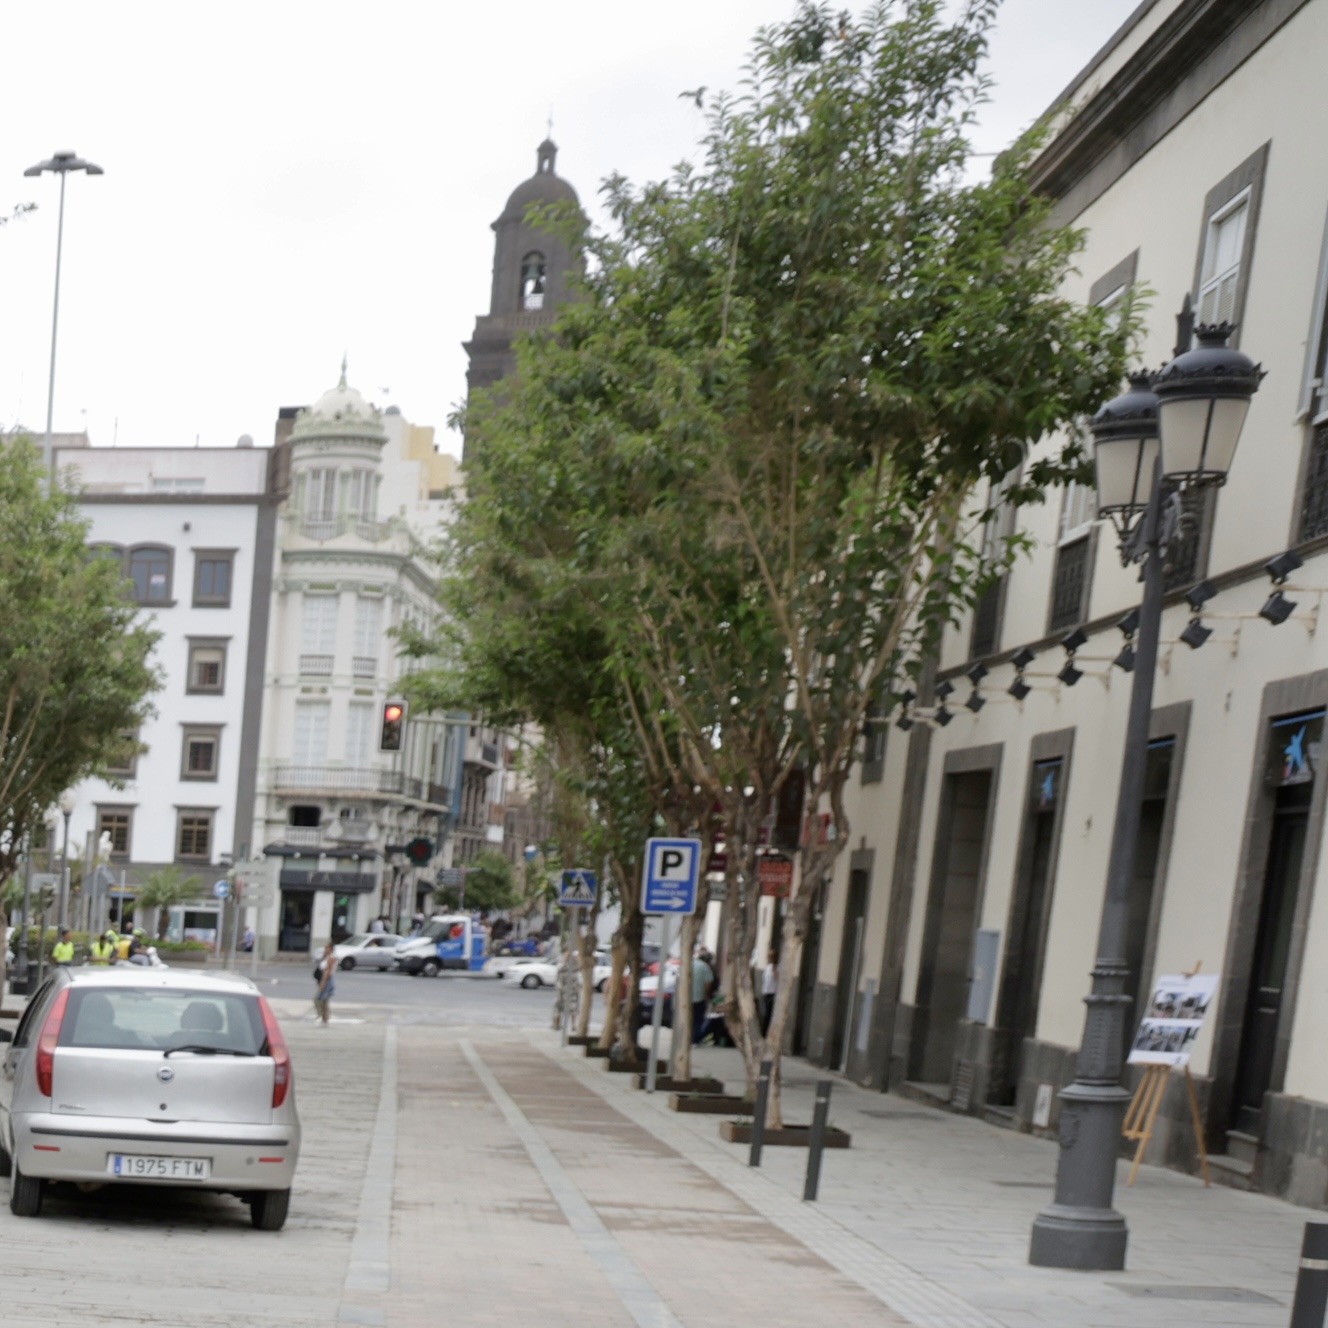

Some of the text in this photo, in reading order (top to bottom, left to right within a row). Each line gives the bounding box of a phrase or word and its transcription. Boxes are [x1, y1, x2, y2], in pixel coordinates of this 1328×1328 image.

[661, 851, 684, 877] P
[127, 1158, 205, 1176] 1975 FTM
